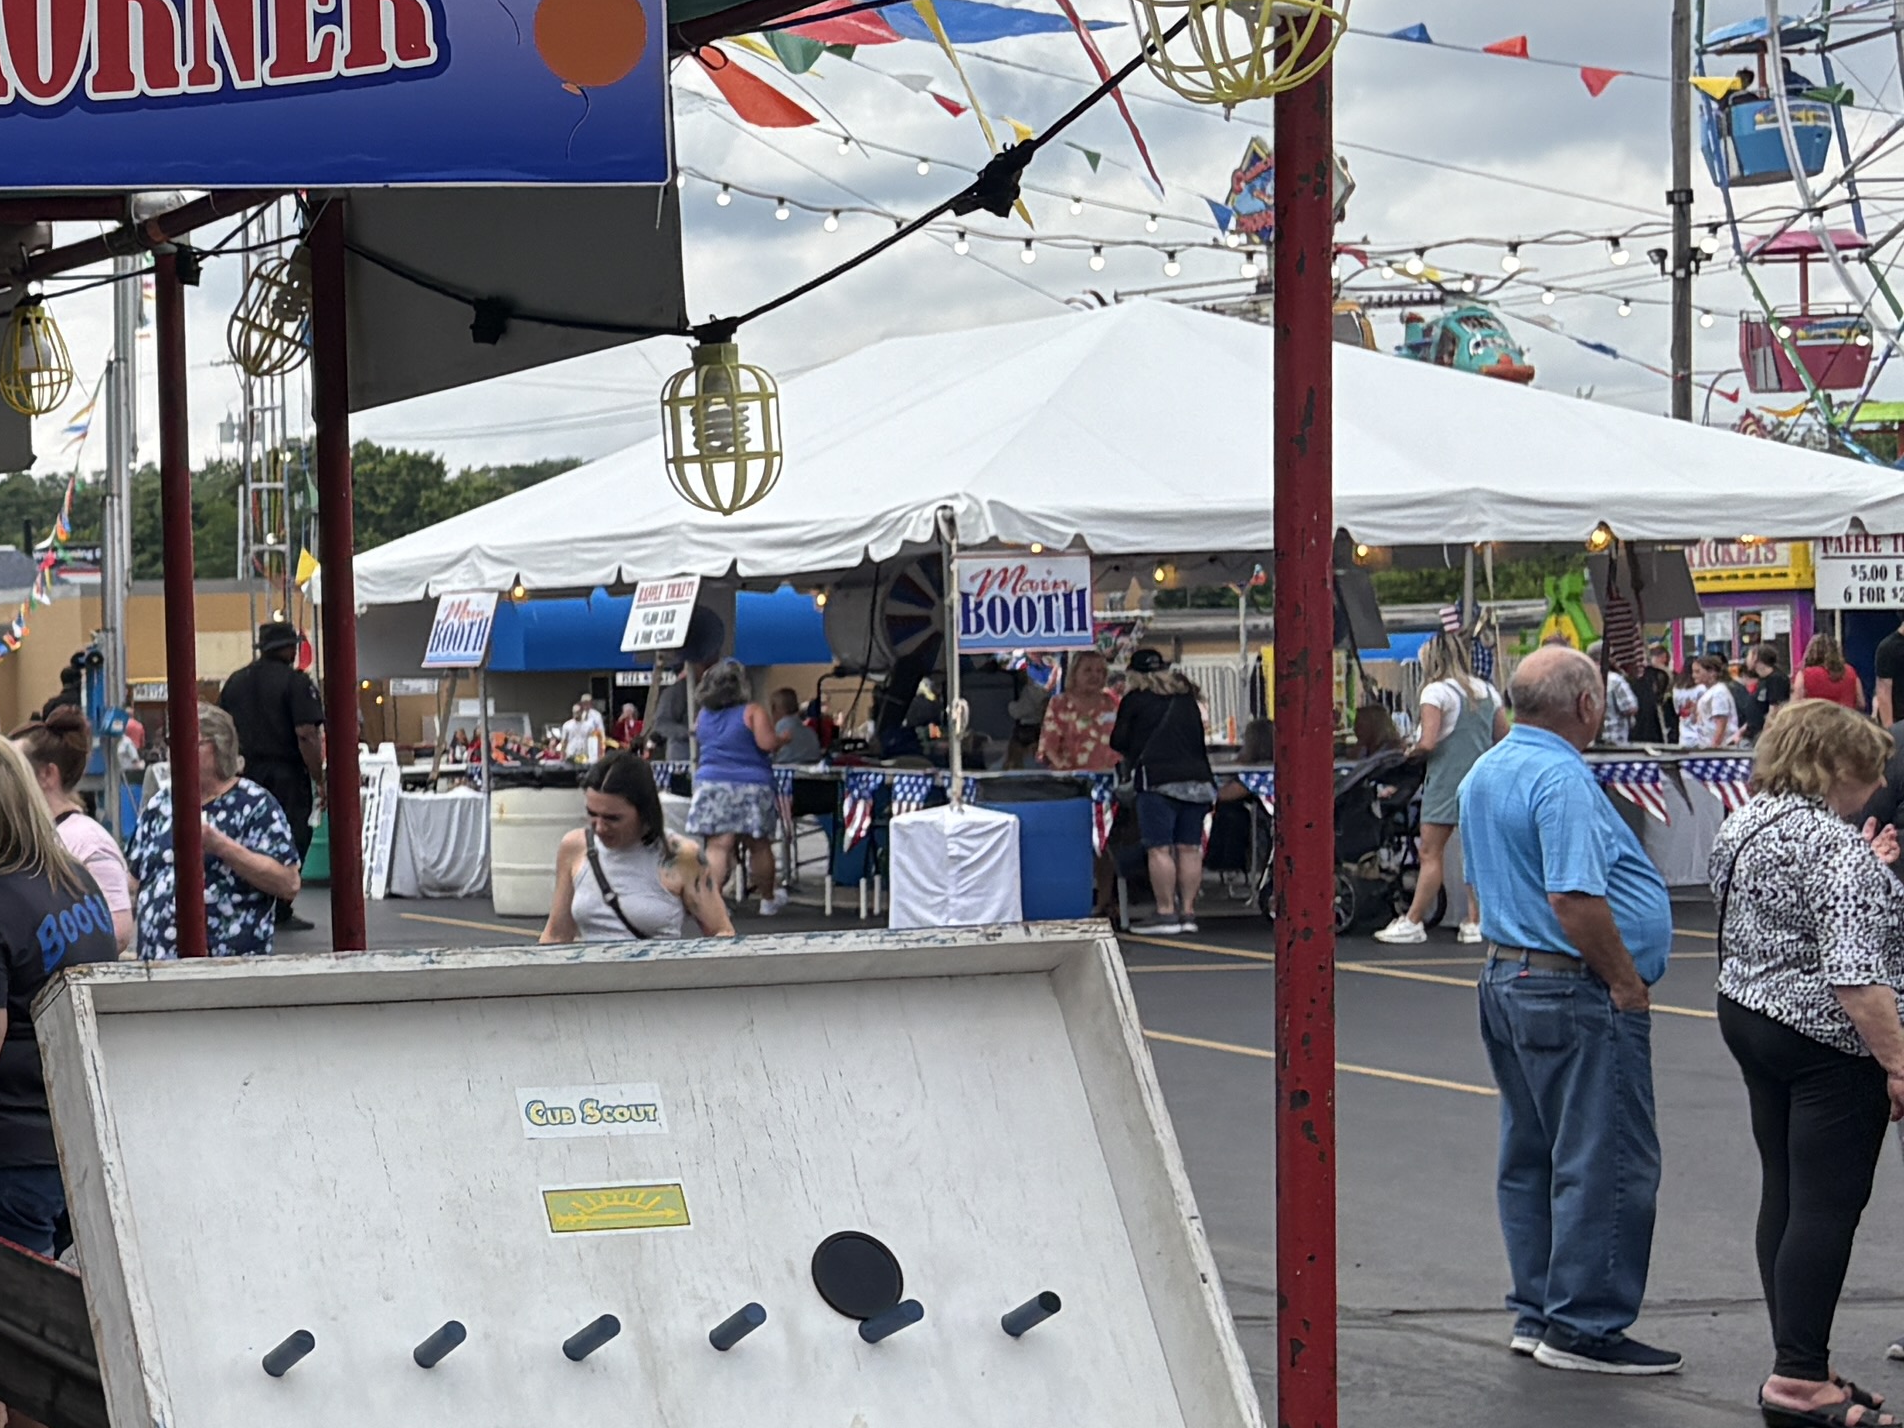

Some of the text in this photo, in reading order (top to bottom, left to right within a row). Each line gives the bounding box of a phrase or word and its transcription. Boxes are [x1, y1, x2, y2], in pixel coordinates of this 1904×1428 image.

[969, 564, 1073, 599] Main
[1851, 564, 1889, 582] $5.00
[1843, 587, 1852, 604] 6
[1859, 586, 1886, 604] FOR
[961, 588, 1089, 636] BOOTH
[429, 617, 489, 652] BOOTH
[525, 1098, 658, 1126] CUB SCOUT
